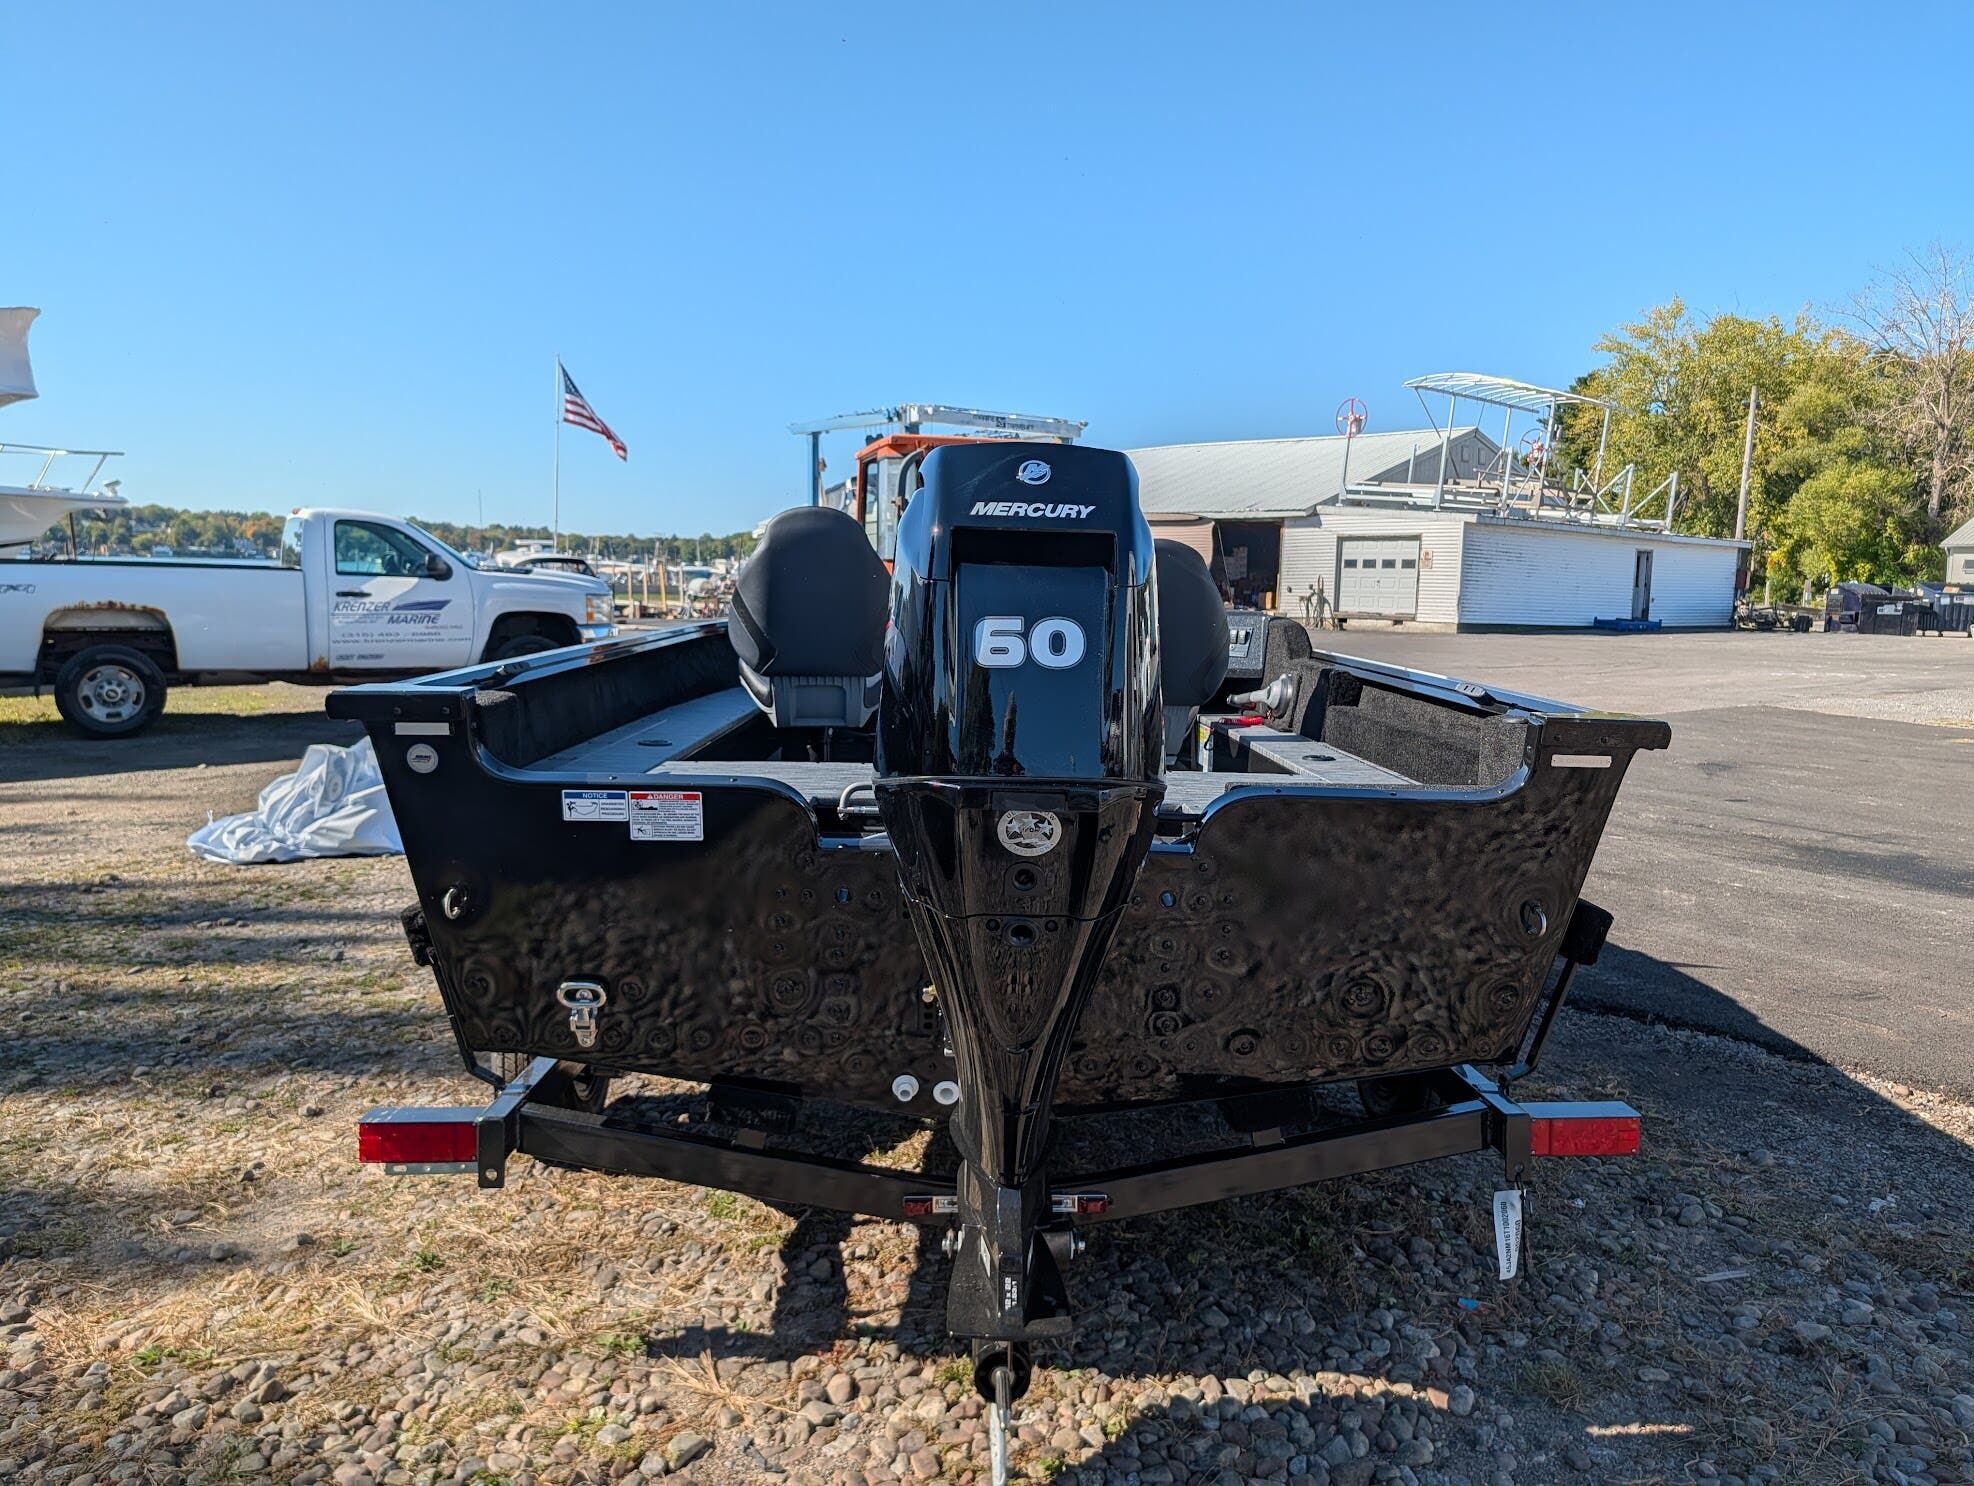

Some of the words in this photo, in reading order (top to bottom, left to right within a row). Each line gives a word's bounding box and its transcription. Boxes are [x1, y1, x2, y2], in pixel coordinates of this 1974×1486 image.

[969, 501, 1096, 519] MERCURY
[333, 601, 391, 612] KRENZER
[387, 614, 441, 625] MARINE
[973, 615, 1087, 670] 60
